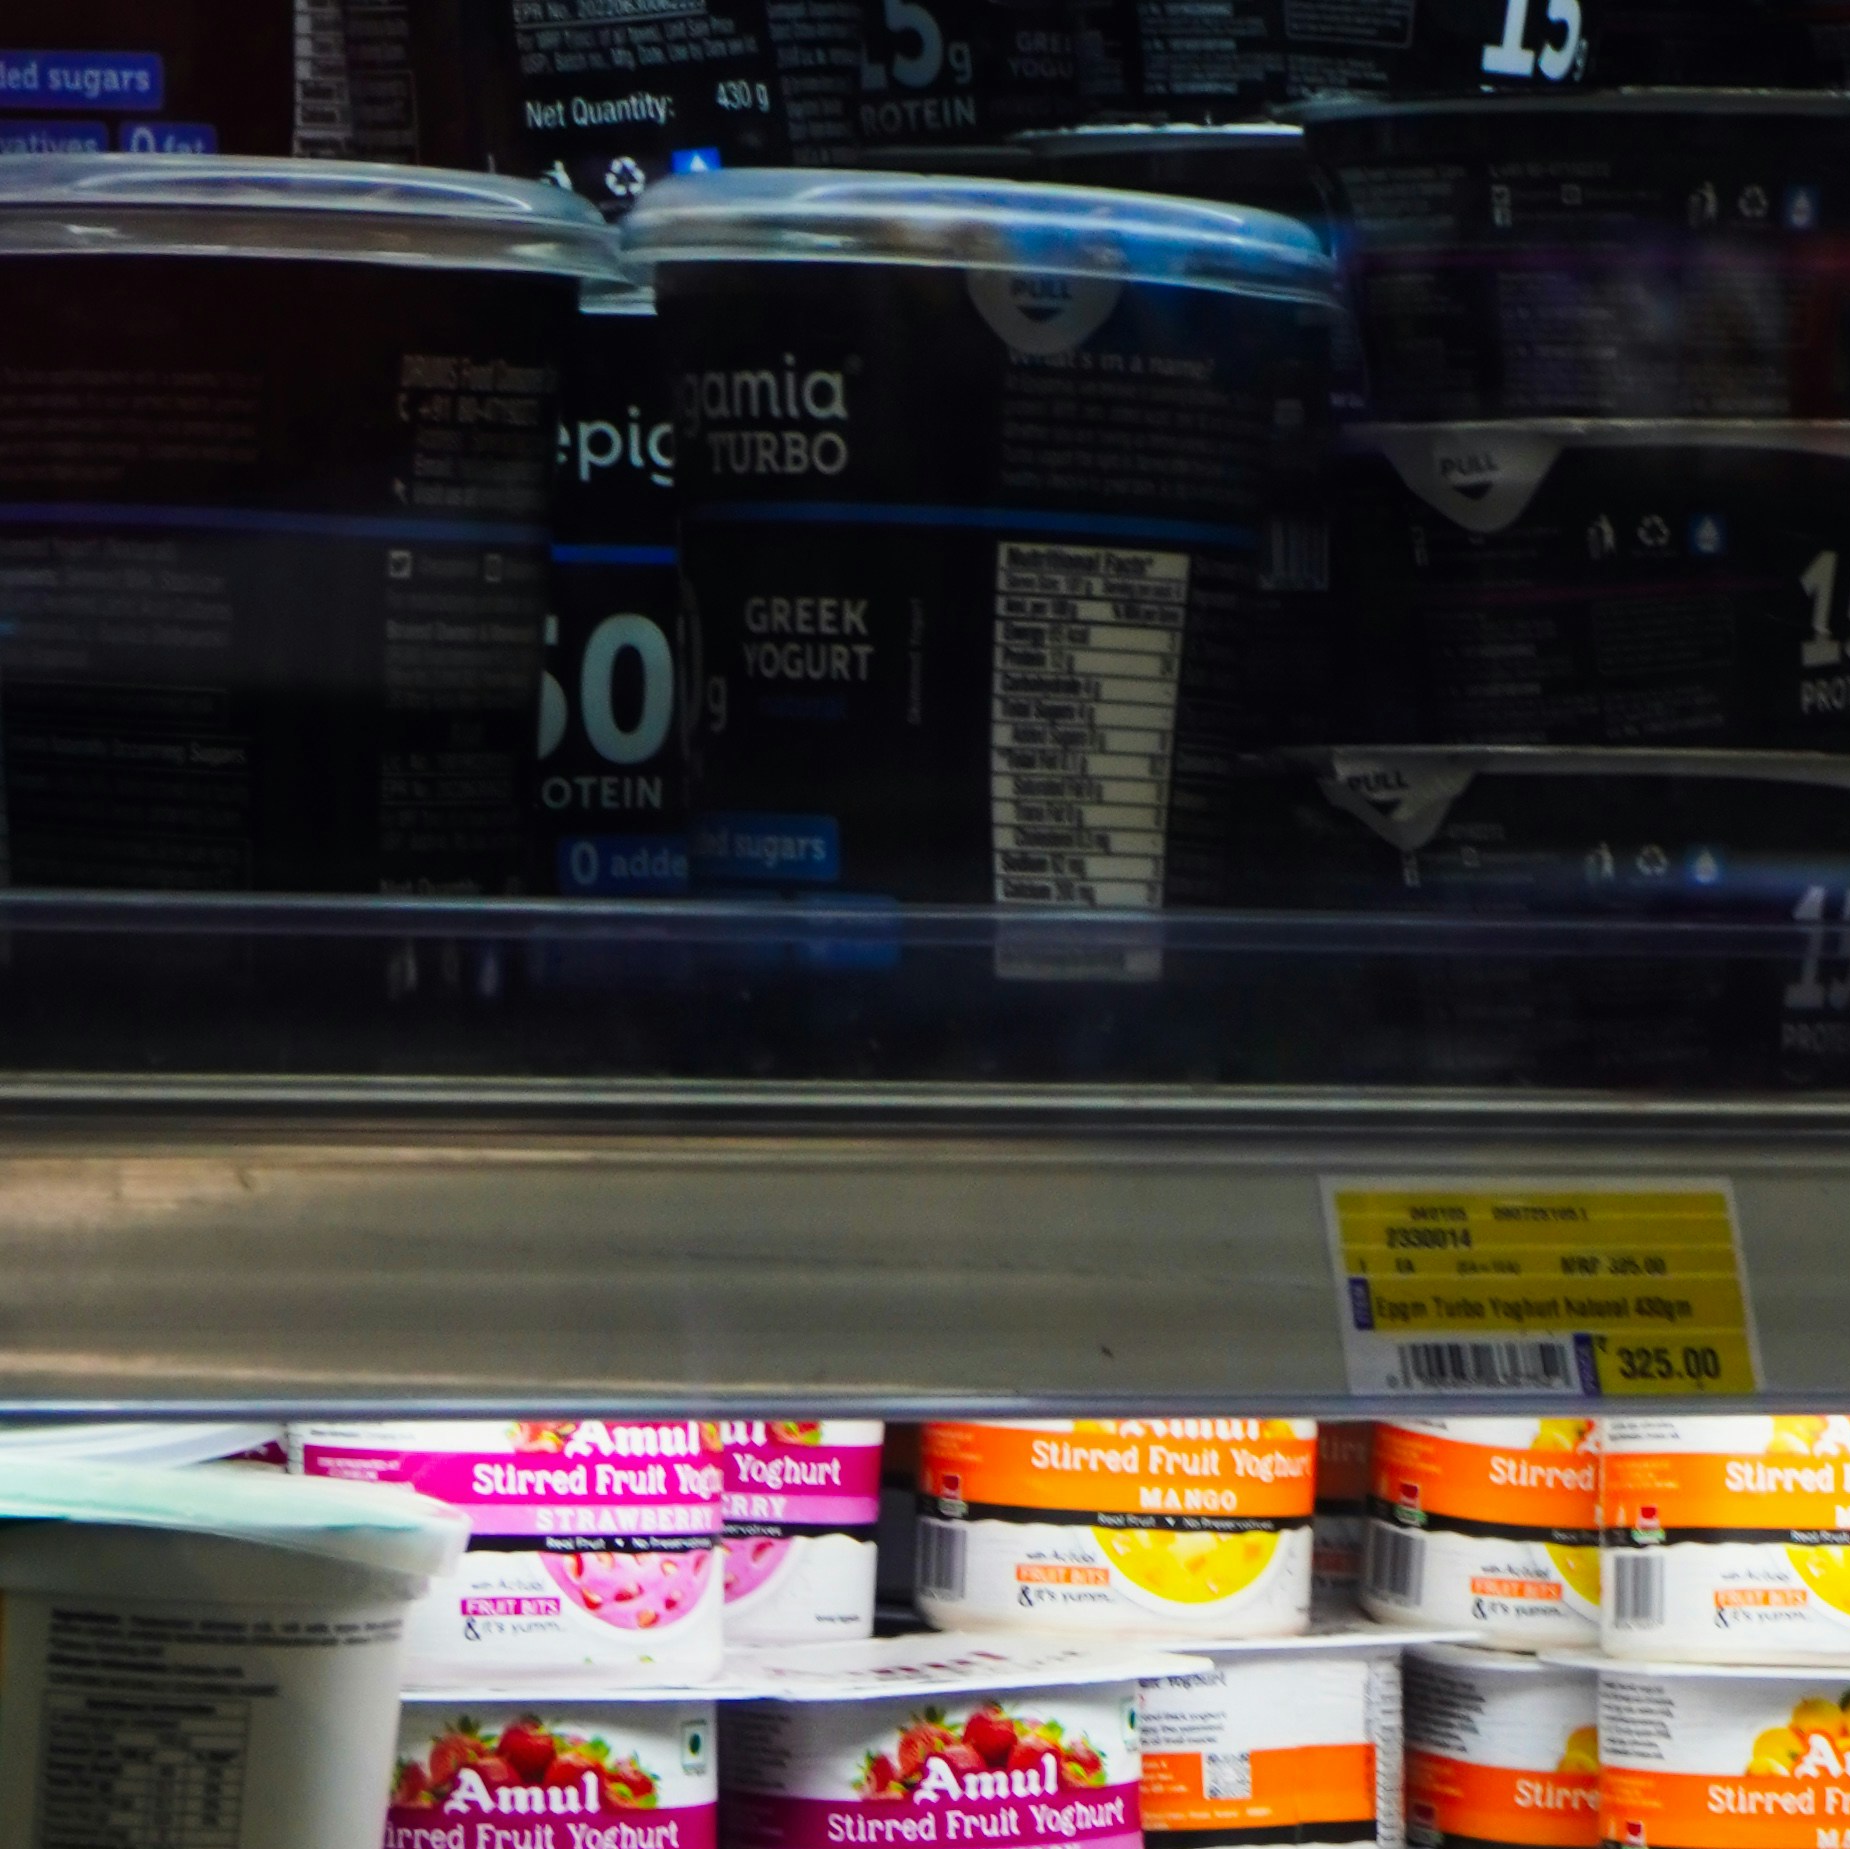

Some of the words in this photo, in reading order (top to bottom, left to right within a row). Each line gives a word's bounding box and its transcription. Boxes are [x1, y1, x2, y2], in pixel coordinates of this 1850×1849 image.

[47, 65, 151, 100] sugars
[525, 100, 566, 129] Net
[571, 92, 676, 127] Quantity:
[715, 80, 751, 111] 430
[707, 432, 848, 476] TURBO
[744, 598, 868, 636] GREEK
[742, 642, 874, 682] YOGURT
[1617, 1346, 1721, 1381] 325.00
[734, 1451, 842, 1491] Yoghurt
[1031, 1440, 1138, 1474] Stirred
[1148, 1443, 1219, 1476] Fruit
[1489, 1456, 1595, 1492] Stirred
[473, 1462, 588, 1497] Stirred
[594, 1462, 665, 1497] Fruit
[1725, 1461, 1834, 1495] Stirred
[1139, 1485, 1238, 1513] MANGO
[443, 1766, 600, 1815] Amul
[913, 1752, 1059, 1804] Amul
[1707, 1784, 1815, 1816] Stirred
[827, 1810, 935, 1844] Stirred
[945, 1806, 1020, 1839] Fruit
[1033, 1796, 1127, 1835] Yoghurt
